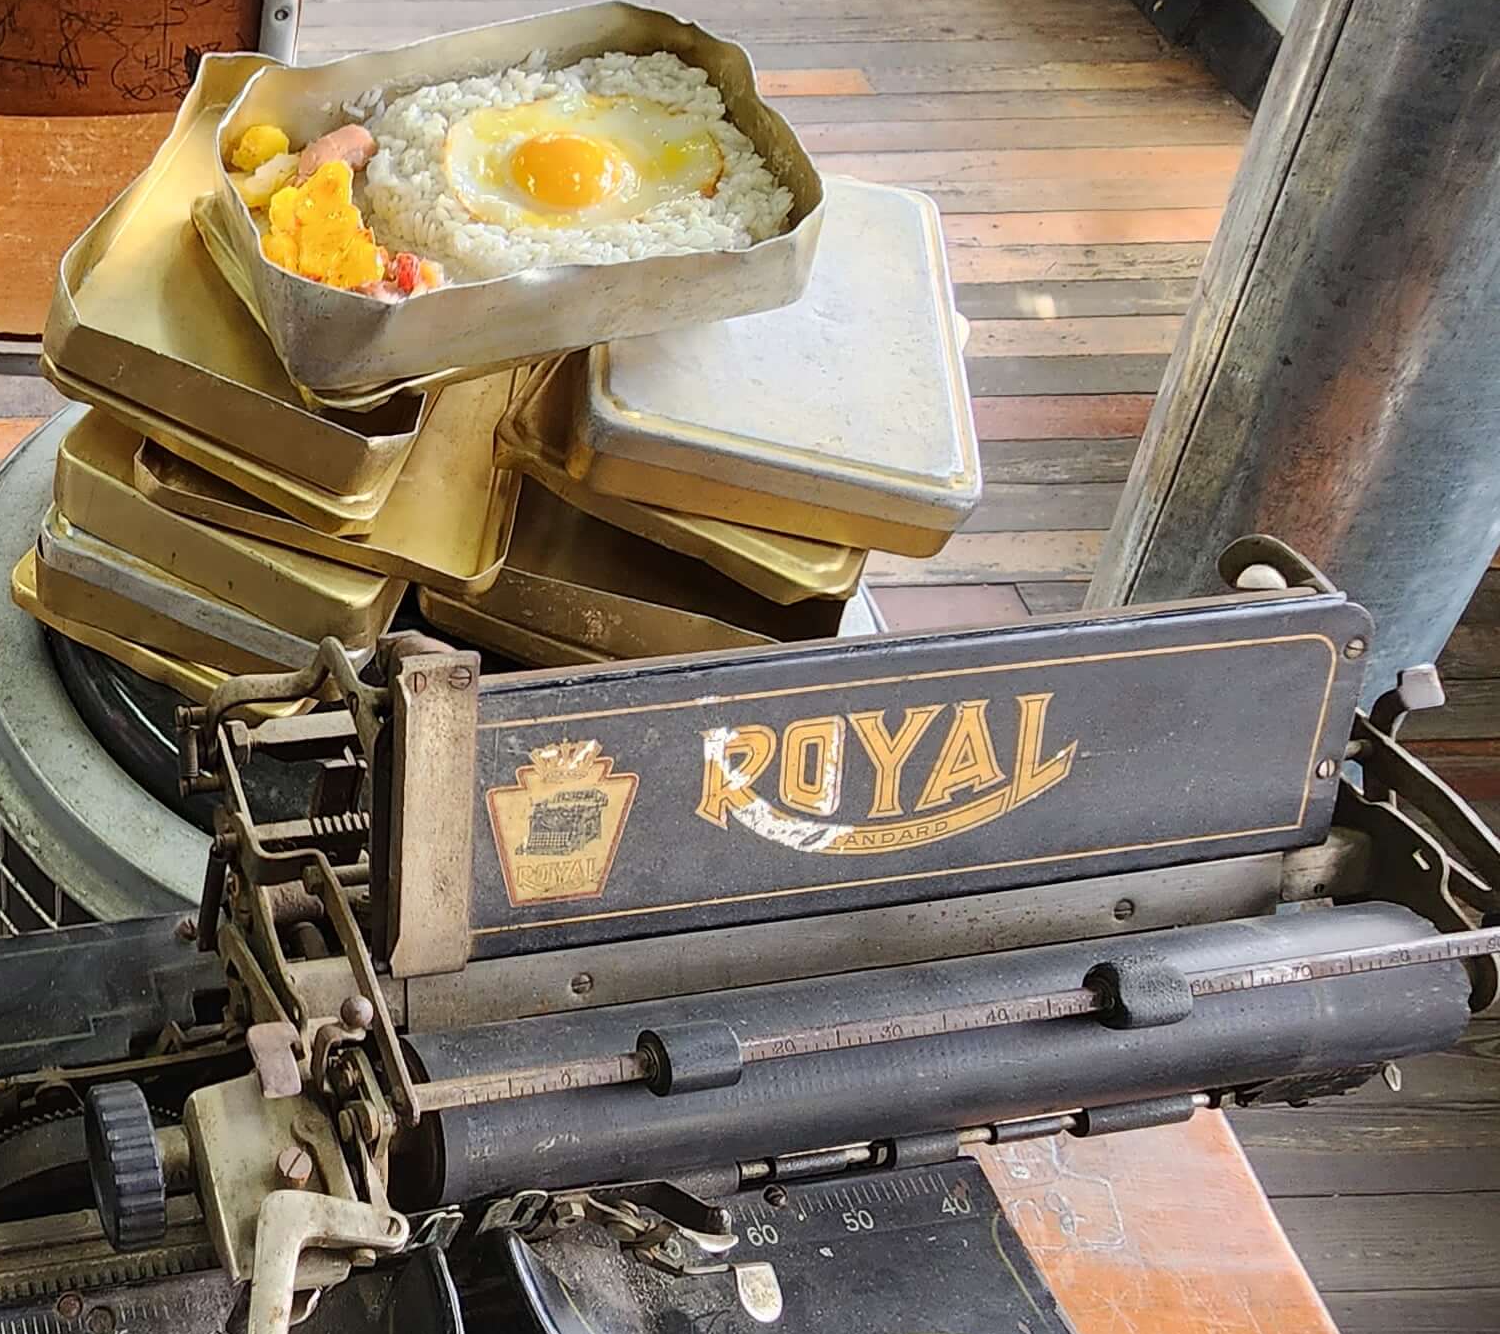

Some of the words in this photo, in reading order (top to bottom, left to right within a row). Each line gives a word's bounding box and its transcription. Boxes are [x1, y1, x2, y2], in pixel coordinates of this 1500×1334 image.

[695, 693, 1079, 830] ROYAL
[516, 858, 603, 889] ROYAL
[747, 1223, 780, 1247] 60
[841, 1210, 875, 1234] 50
